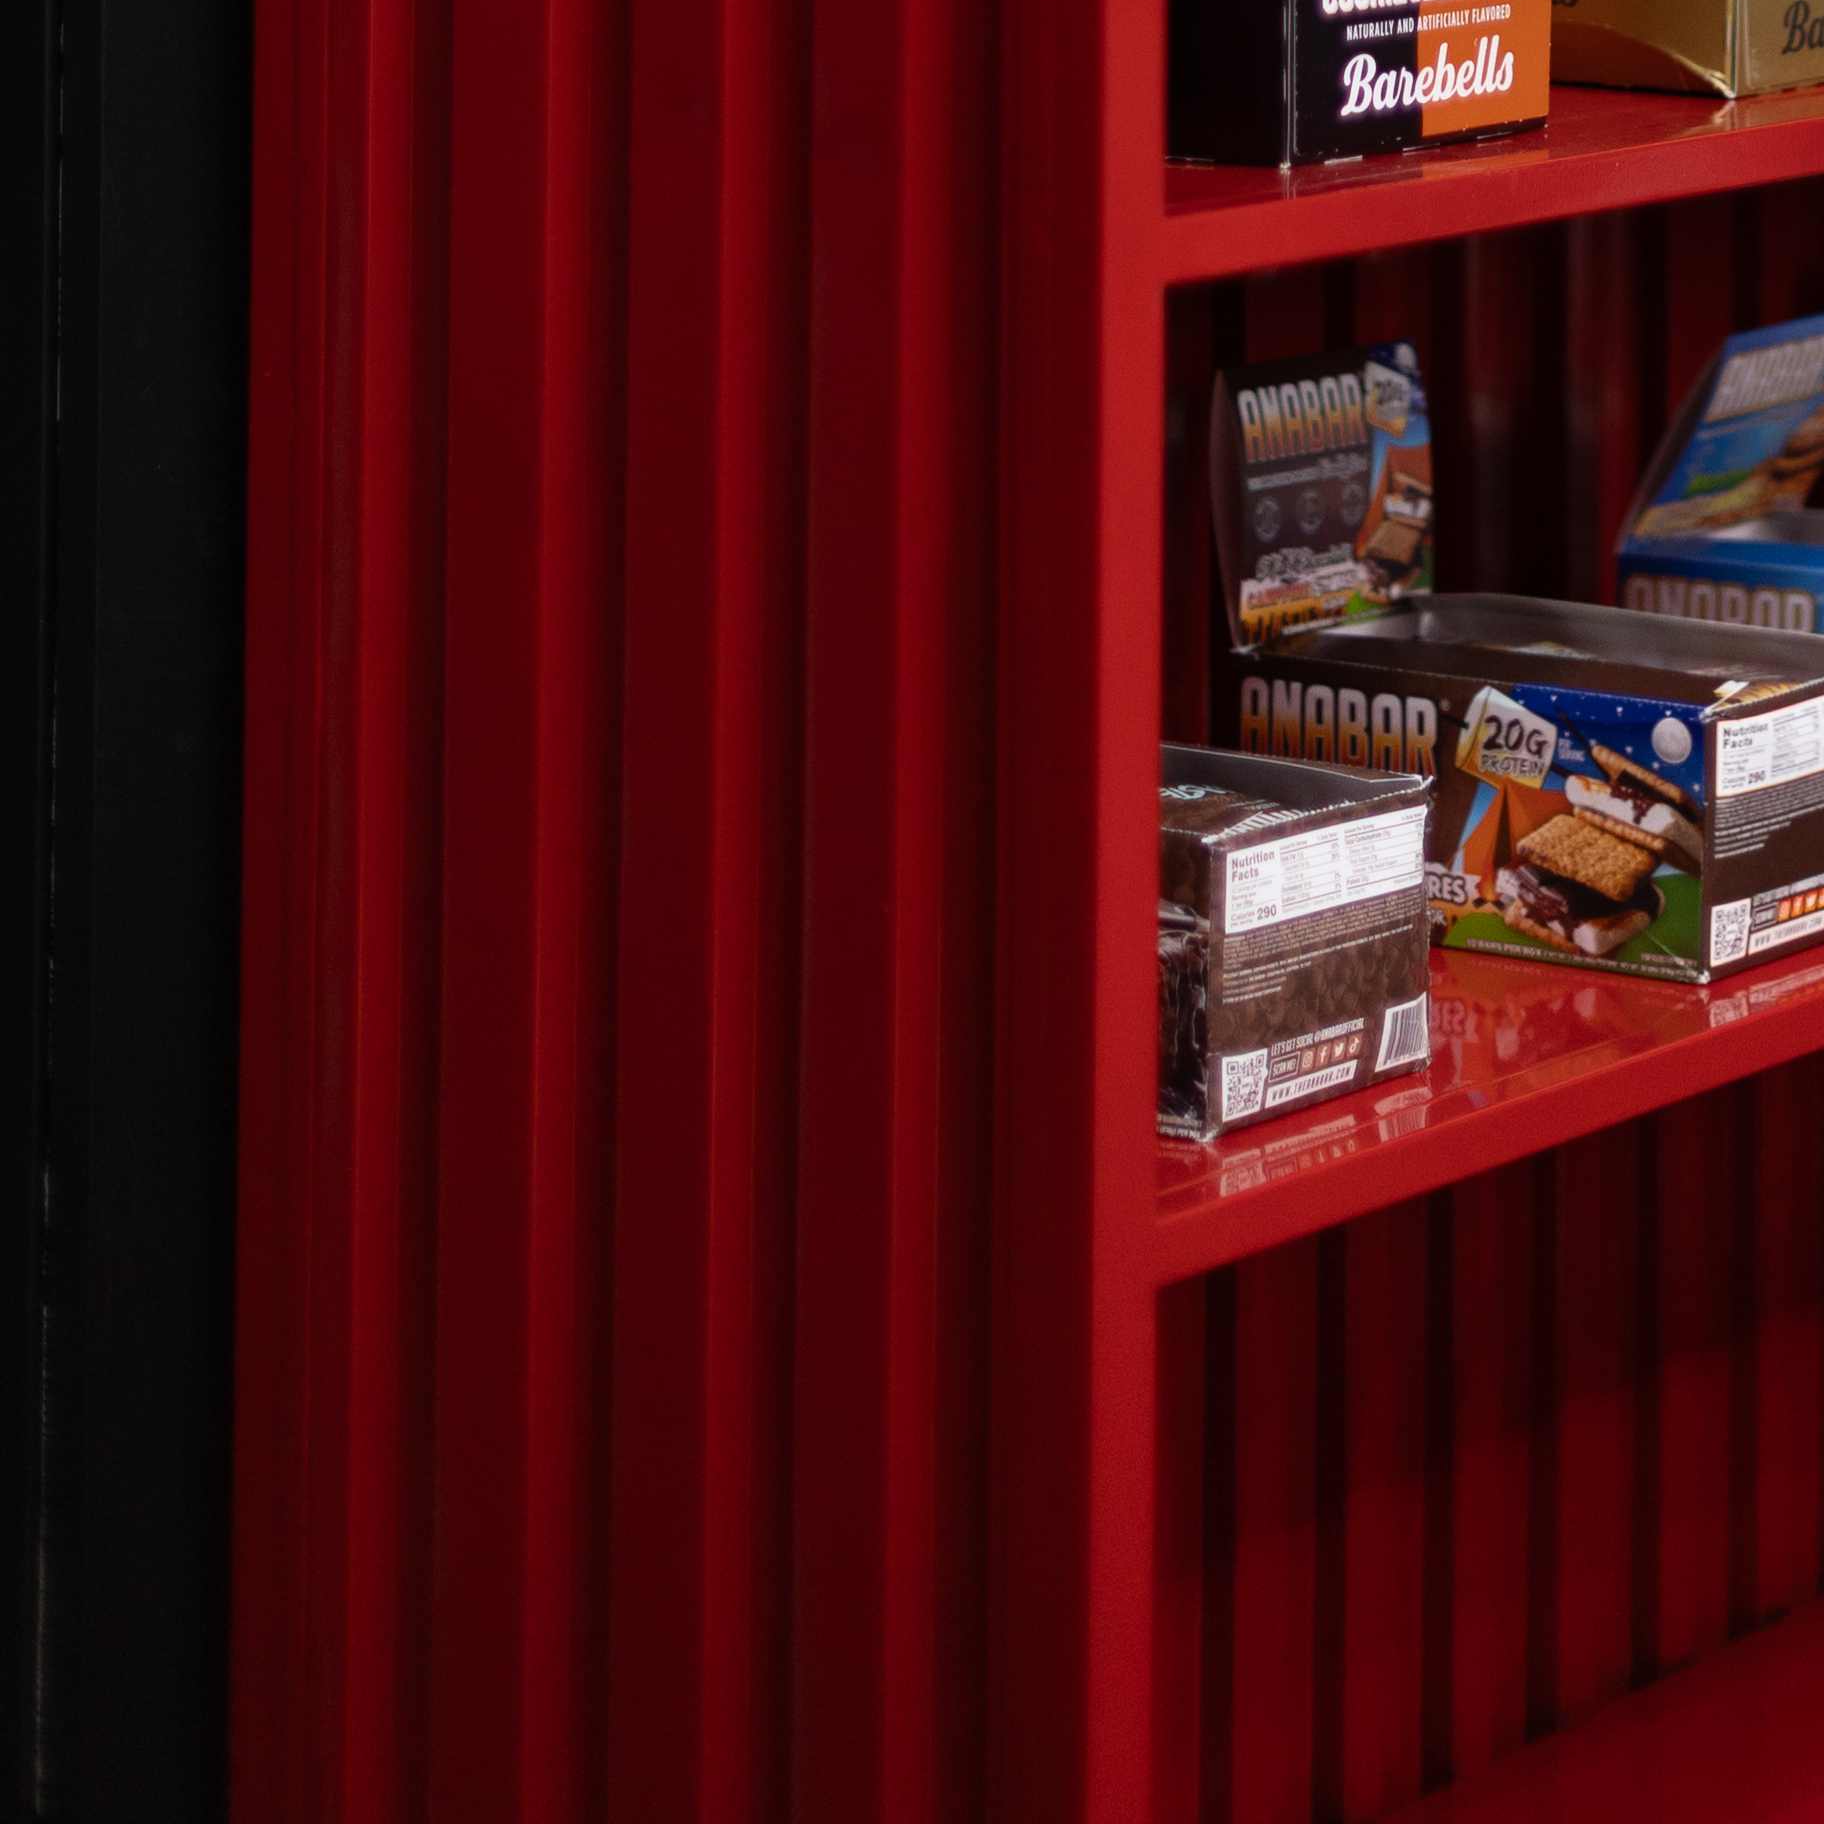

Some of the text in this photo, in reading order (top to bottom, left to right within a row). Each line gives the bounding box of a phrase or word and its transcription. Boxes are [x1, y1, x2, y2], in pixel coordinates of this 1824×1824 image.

[1346, 3, 1512, 41] NATURALLY AND ARTIFICIALLY FLAVORED
[1340, 34, 1515, 117] Barebells
[1237, 372, 1368, 463] ANABAR
[1240, 675, 1438, 777] ANABAR
[1483, 714, 1549, 759] 20G
[1481, 754, 1546, 778] PROTEIN
[1231, 850, 1275, 870] Nutrition
[1231, 867, 1260, 883] Facts
[1256, 904, 1277, 921] 290
